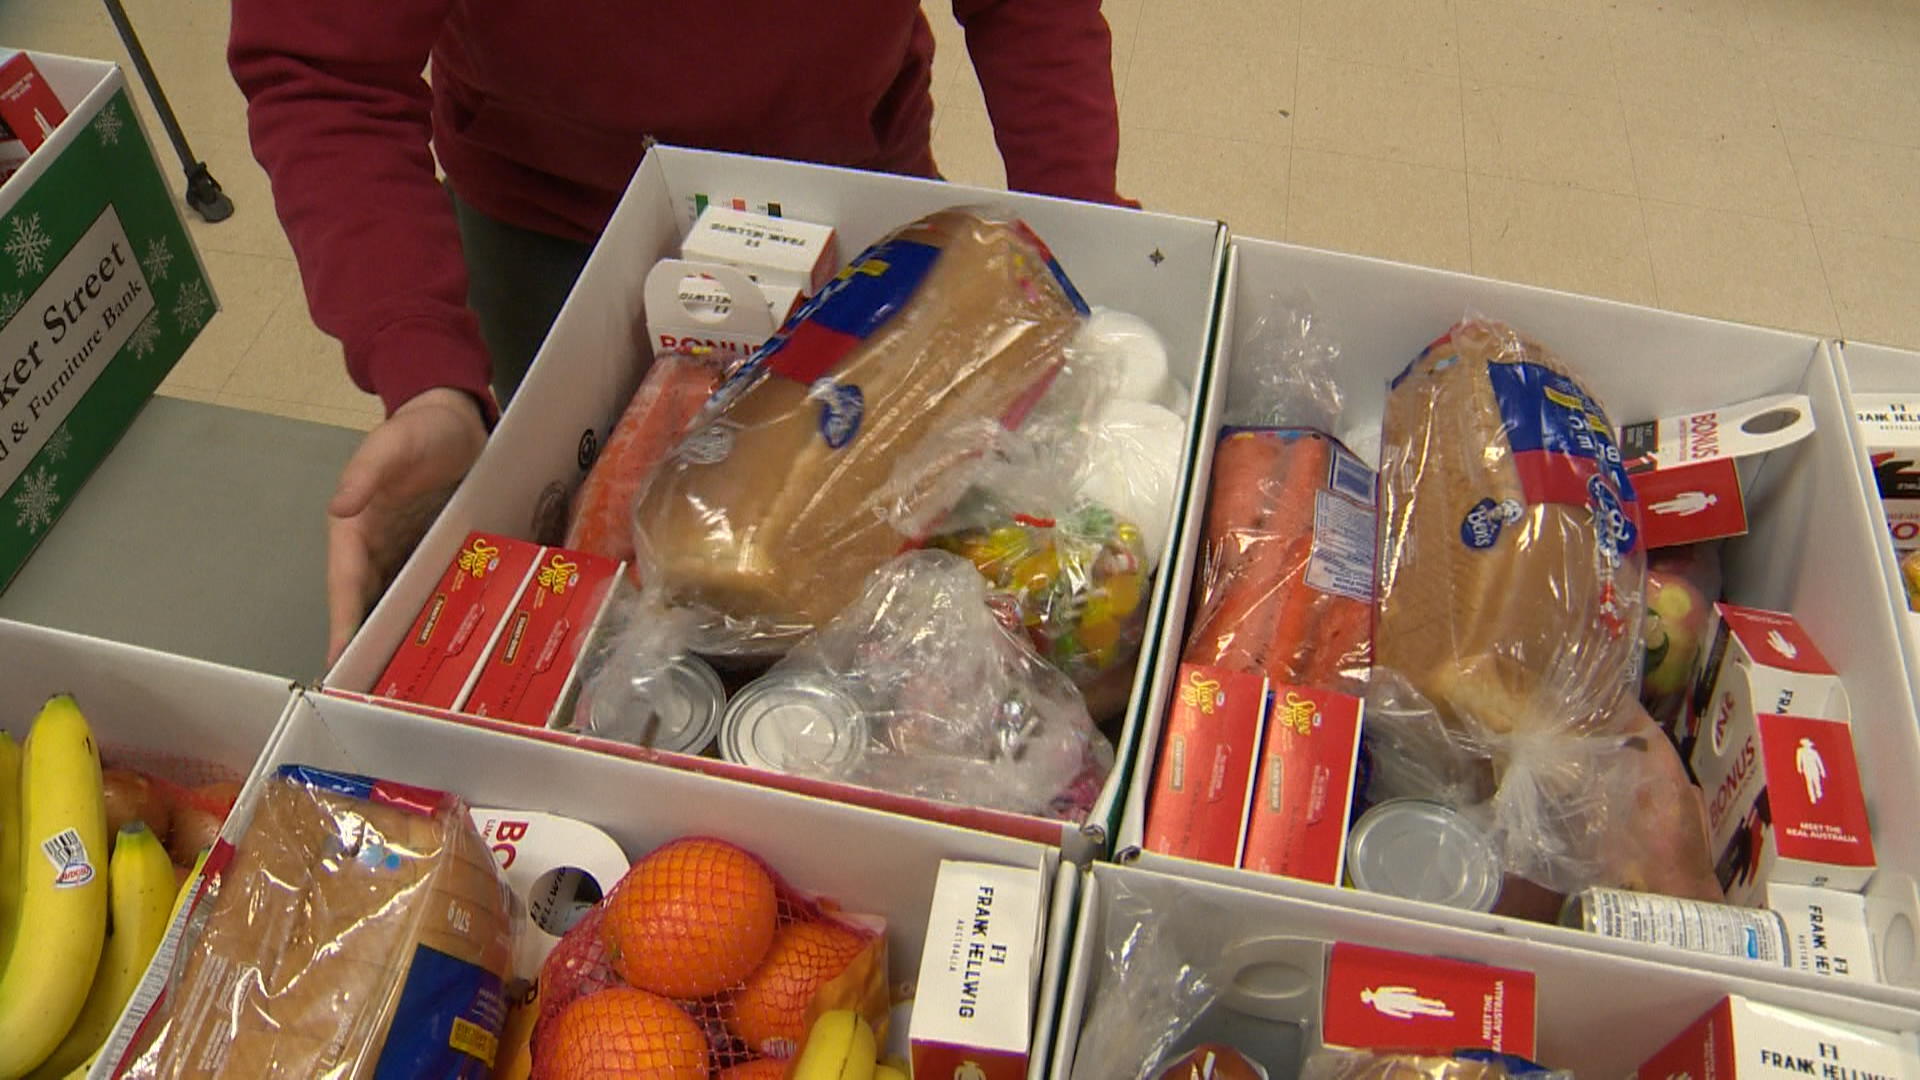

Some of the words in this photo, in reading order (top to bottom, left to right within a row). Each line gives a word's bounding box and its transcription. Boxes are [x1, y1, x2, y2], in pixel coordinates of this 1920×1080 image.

[43, 240, 126, 344] Street
[11, 420, 29, 443] &
[27, 329, 102, 422] Furniture
[101, 278, 143, 331] Bank
[1691, 412, 1719, 459] BONUS
[1710, 738, 1755, 826] BONUS
[1786, 827, 1808, 837] REAL
[1809, 830, 1858, 844] AUSTRALIA
[1800, 821, 1823, 832] MEET
[1824, 823, 1842, 833] THE
[972, 886, 994, 937] FRANK
[1808, 904, 1827, 950] FRANK
[958, 942, 985, 1019] HELLWIG
[1485, 994, 1493, 1013] THE
[1482, 1013, 1493, 1041] MEET
[1493, 980, 1504, 1029] AUSTRALIA
[1761, 1049, 1815, 1075] FRANK
